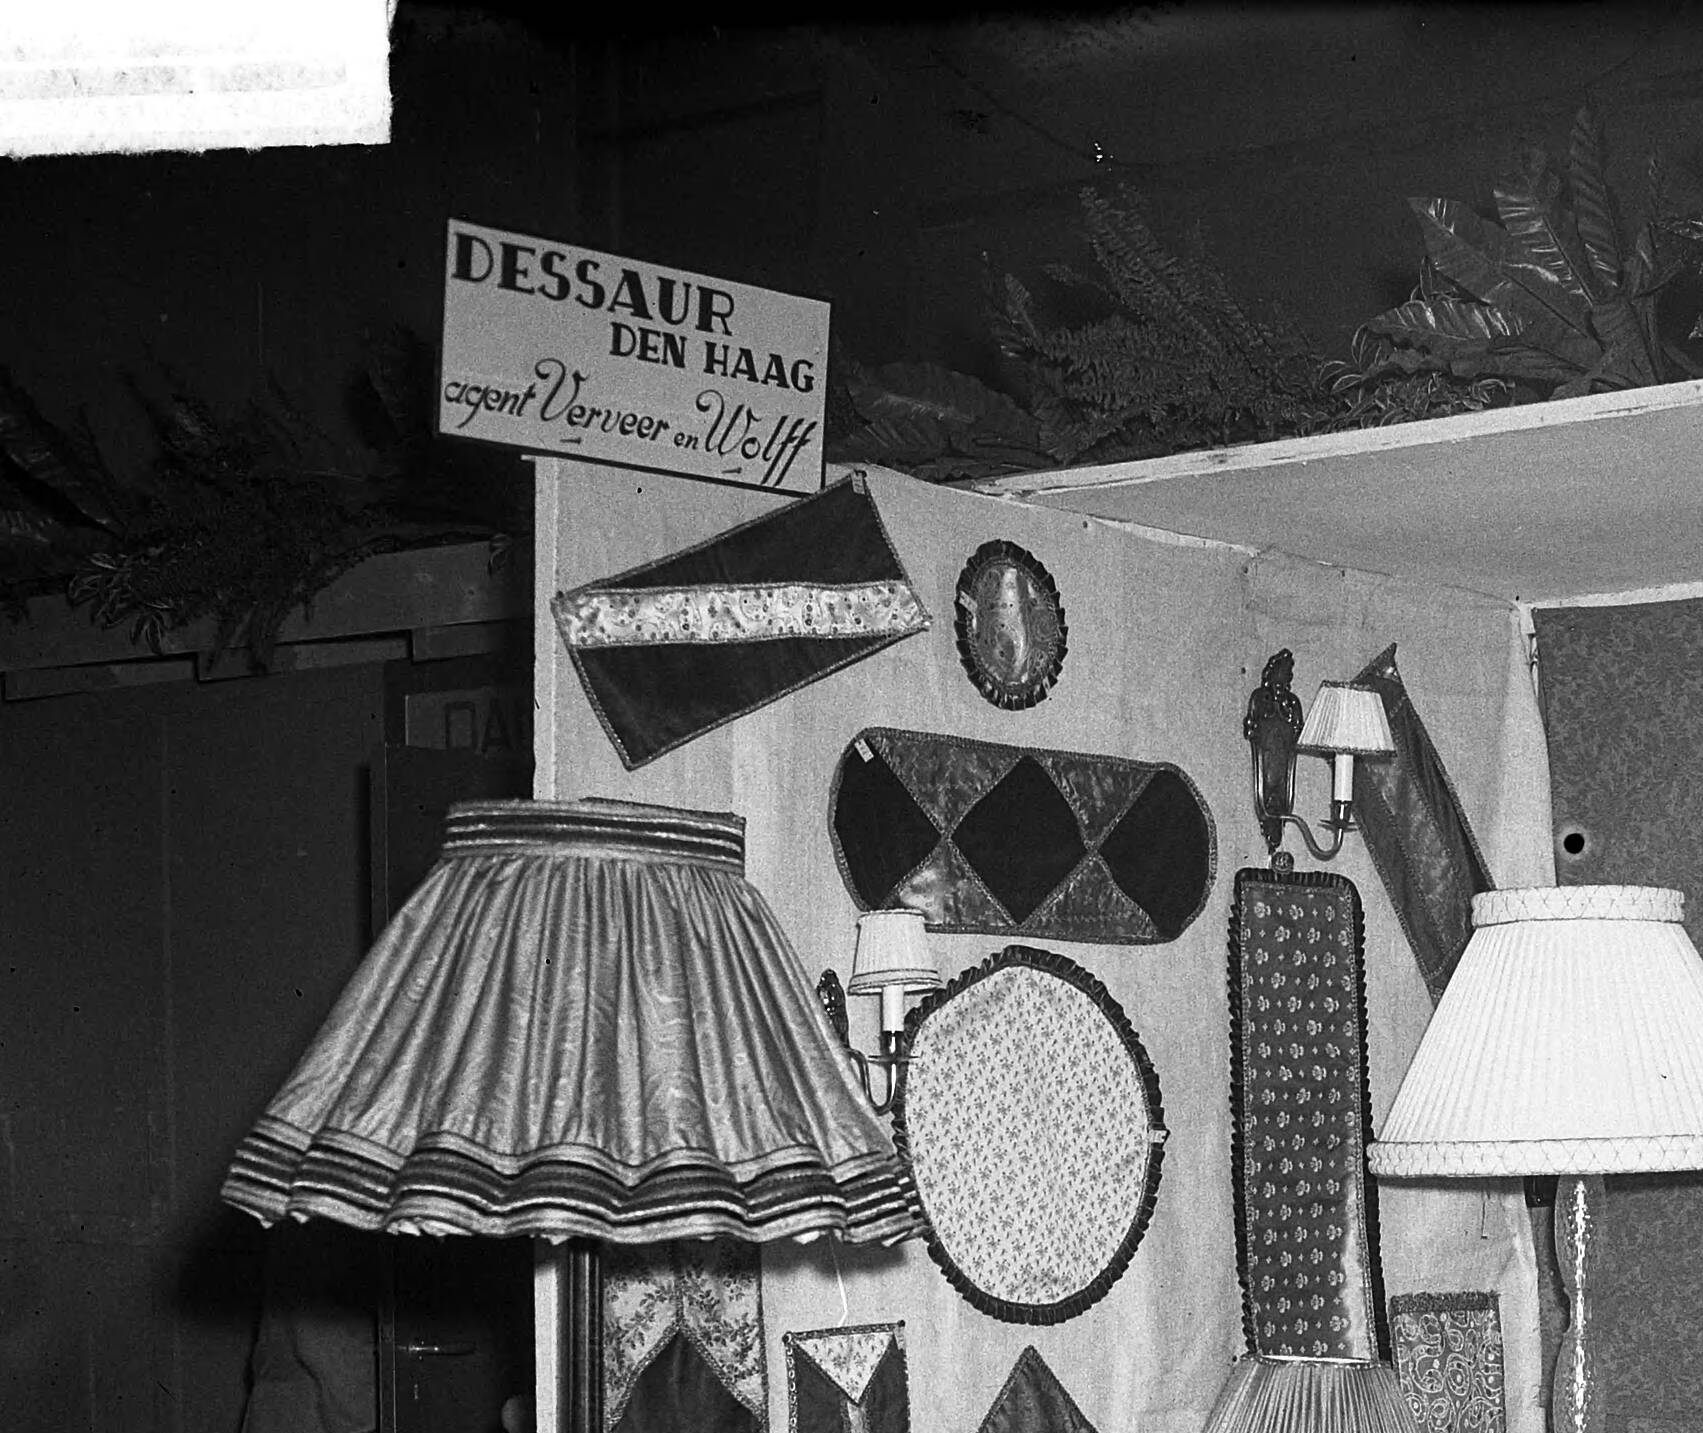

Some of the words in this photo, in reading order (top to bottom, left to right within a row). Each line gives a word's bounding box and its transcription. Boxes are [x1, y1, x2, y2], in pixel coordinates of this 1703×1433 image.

[451, 232, 735, 336] DESSAUR
[609, 321, 688, 368] DEN
[703, 340, 815, 393] HAAG
[444, 380, 536, 429] agent
[534, 357, 670, 441] Verveer
[673, 430, 700, 451] en
[695, 388, 818, 487] Wolff
